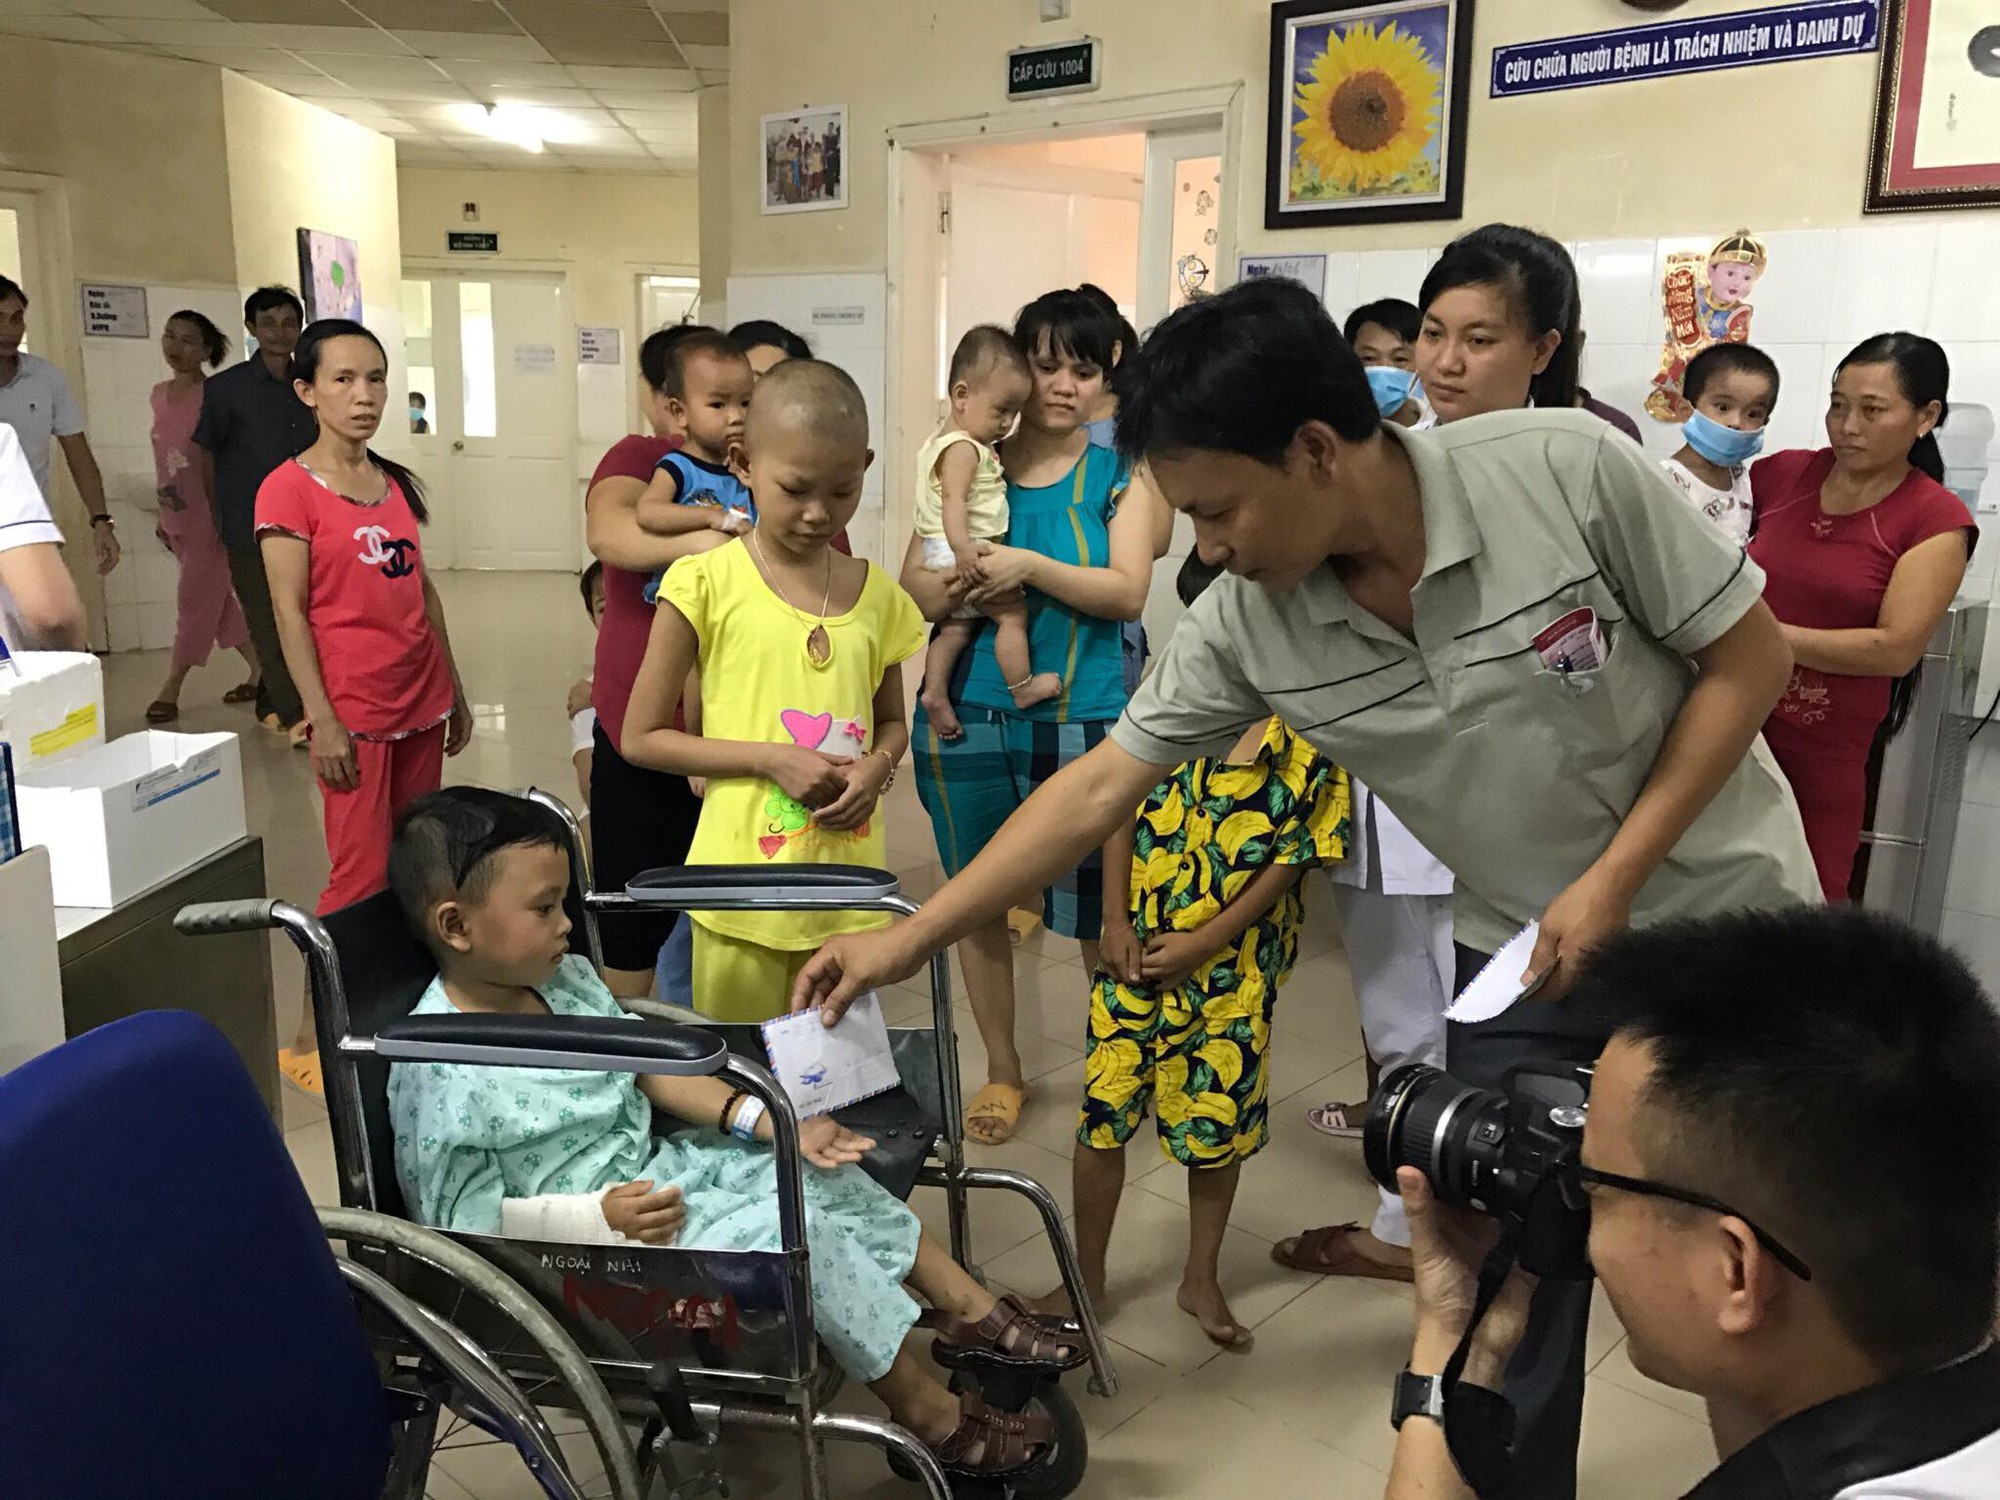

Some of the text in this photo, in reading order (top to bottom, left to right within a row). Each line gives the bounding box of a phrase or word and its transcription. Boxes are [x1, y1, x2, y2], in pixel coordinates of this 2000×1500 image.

[1505, 12, 1866, 84] CỨU CHỮA NGƯỜI BỆNH LÀ TRÁCH NHIỆM VÀ DANH DỰ
[1012, 58, 1084, 83] CẤP CỨU 1004
[1666, 272, 1692, 289] Chúc
[1676, 319, 1695, 339] Mới
